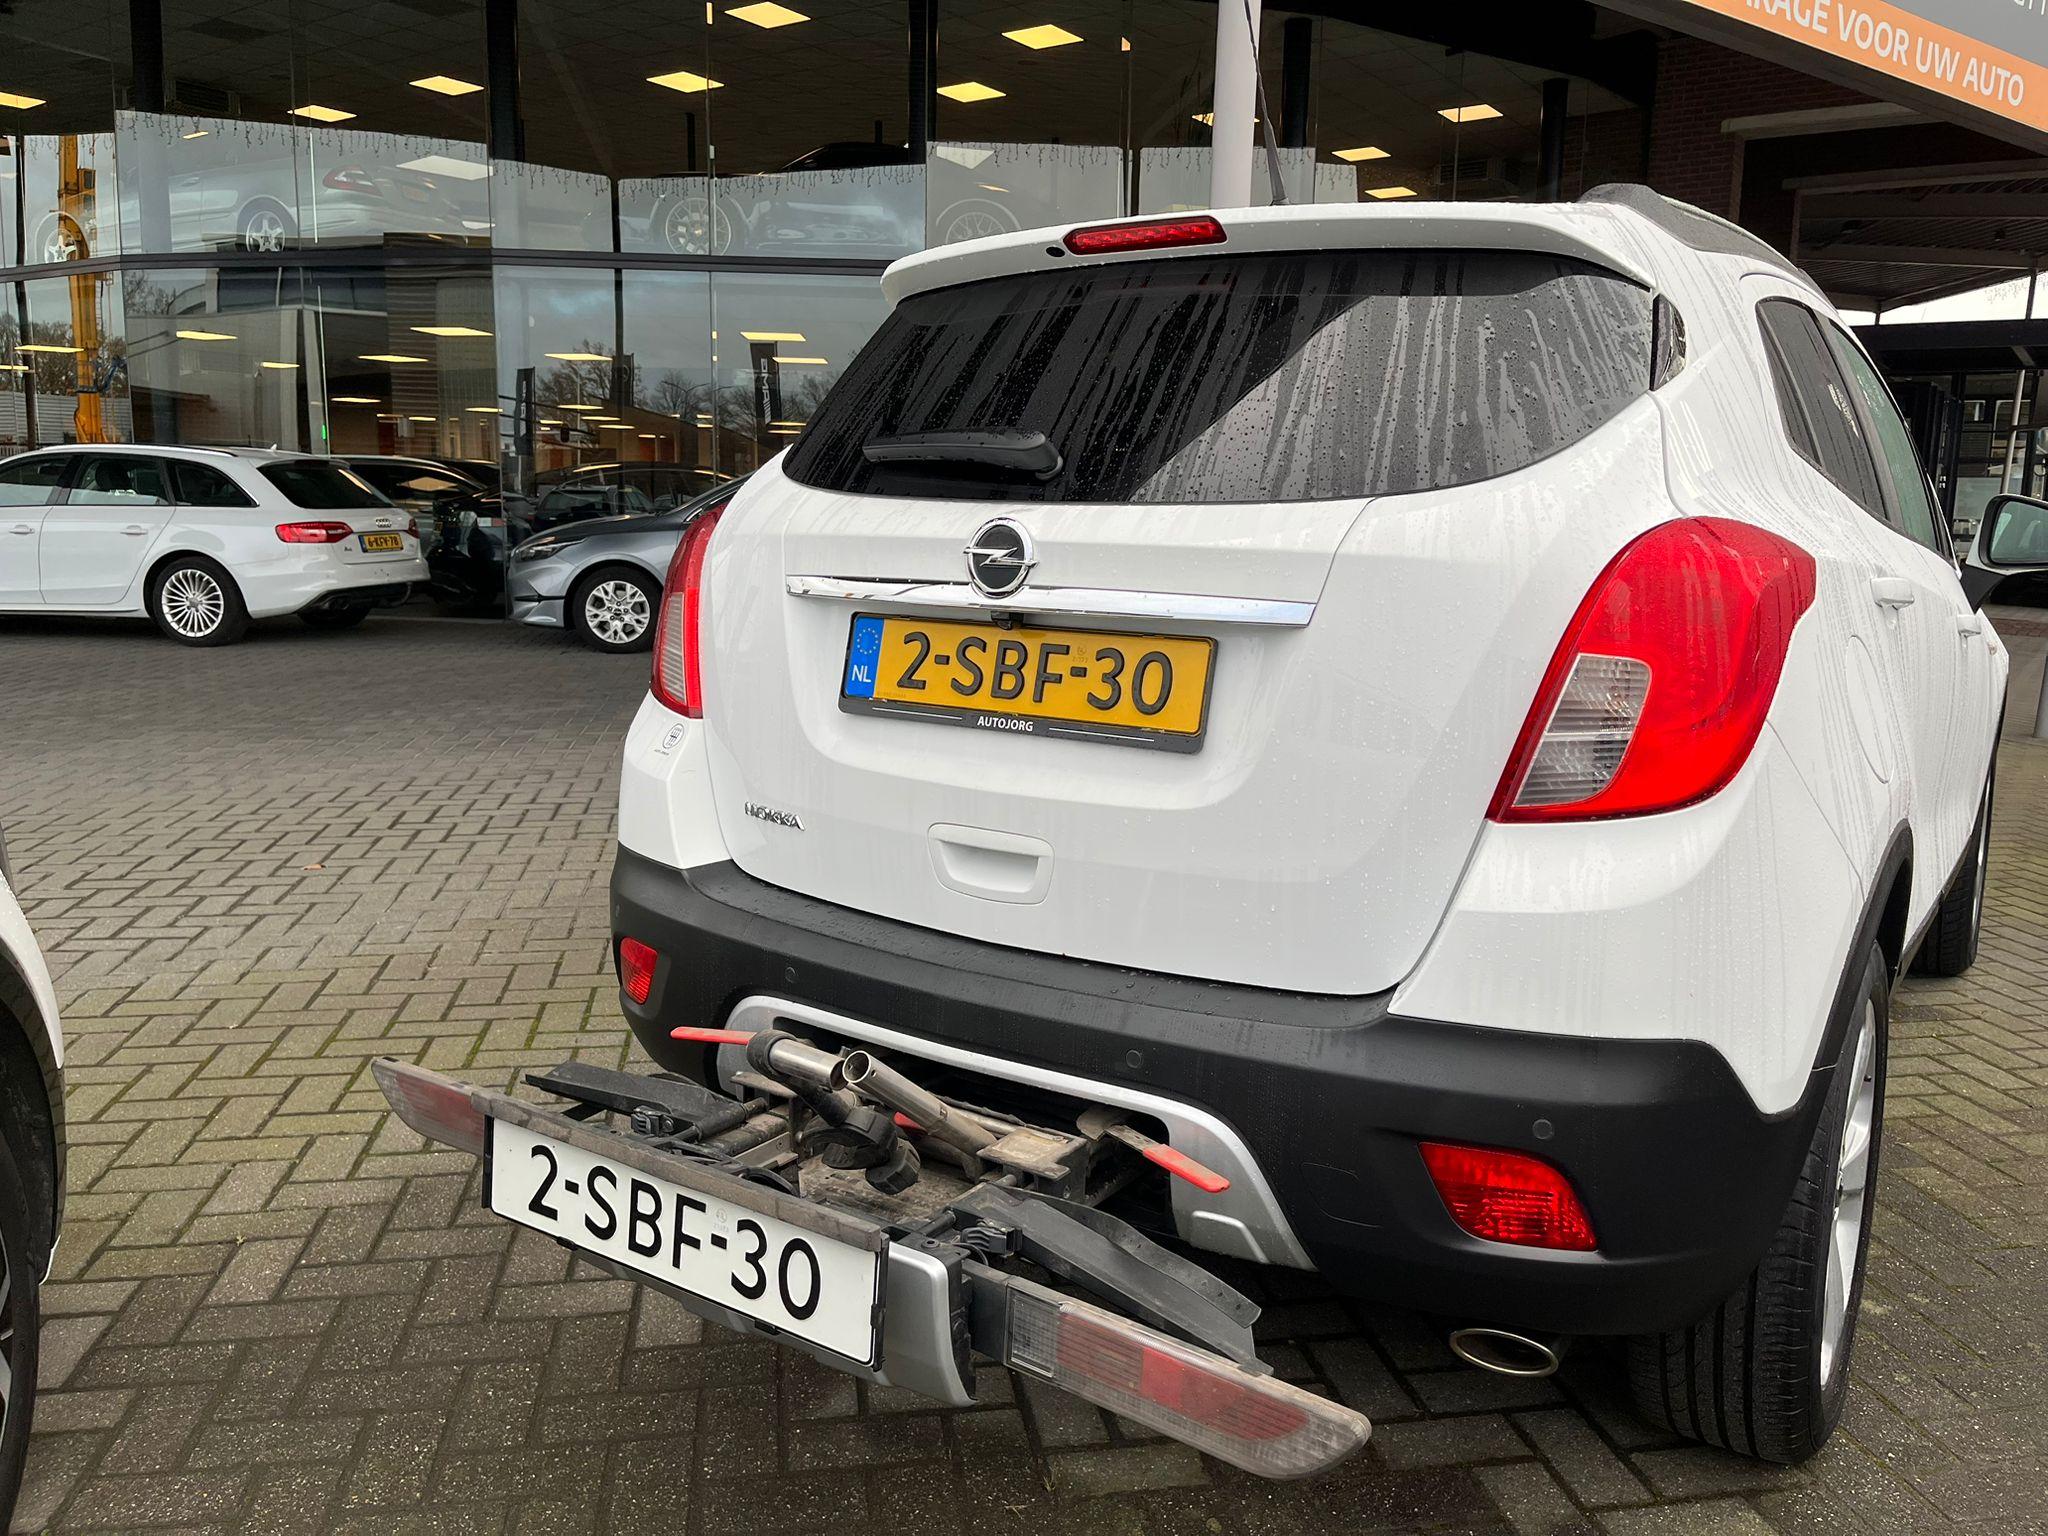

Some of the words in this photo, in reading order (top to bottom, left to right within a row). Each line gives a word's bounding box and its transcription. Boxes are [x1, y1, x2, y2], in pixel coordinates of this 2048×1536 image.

[1837, 3, 1909, 66] VOOR
[1915, 36, 1961, 83] UW
[1961, 57, 2024, 106] AUTO
[851, 664, 872, 683] NL
[896, 631, 1173, 716] 2-SBF-30
[976, 715, 1034, 732] AUTOJORG
[744, 801, 805, 832] MOKKA
[528, 1144, 822, 1321] 2-SBF-30
